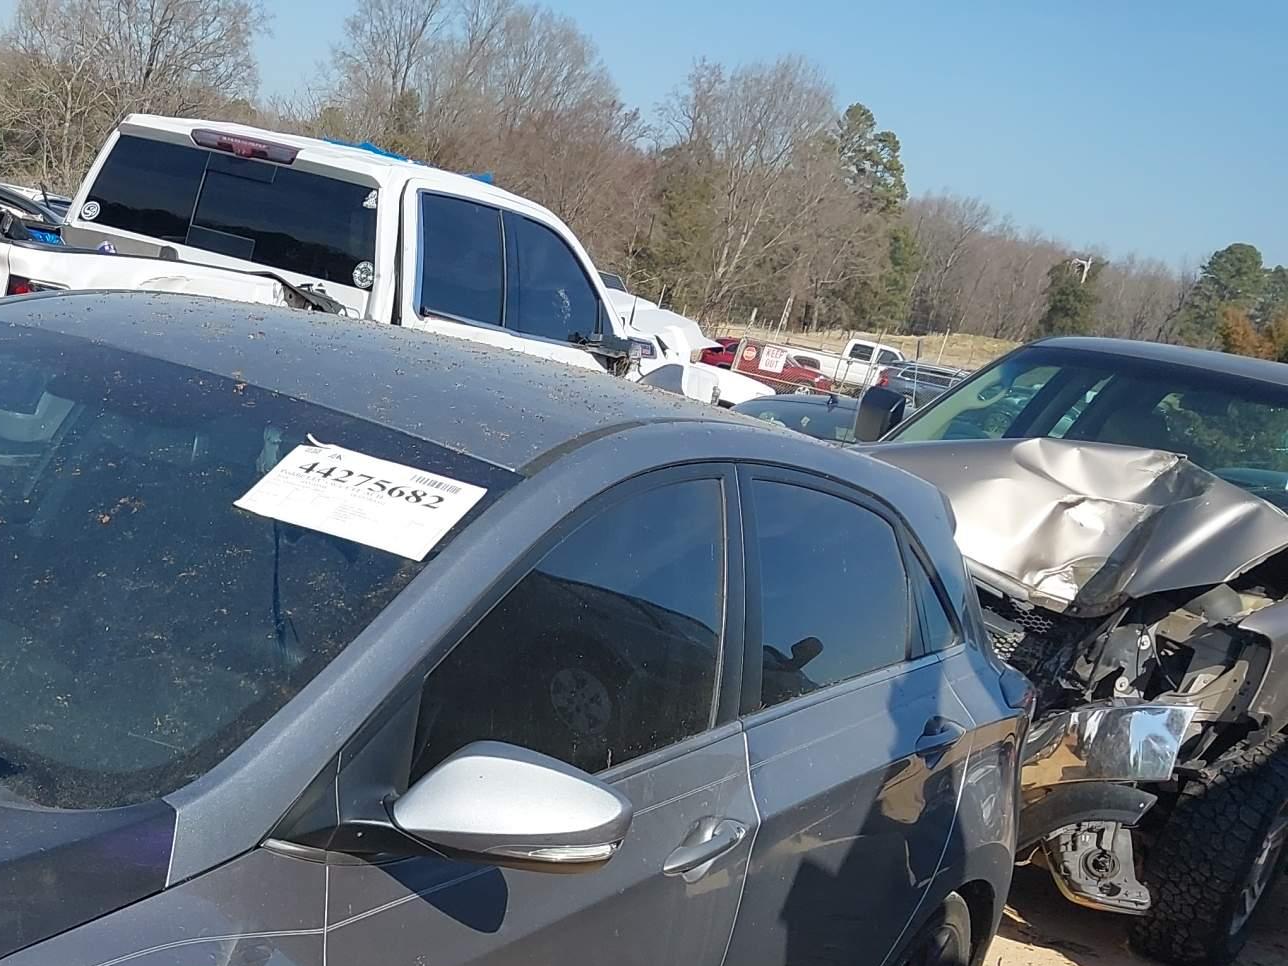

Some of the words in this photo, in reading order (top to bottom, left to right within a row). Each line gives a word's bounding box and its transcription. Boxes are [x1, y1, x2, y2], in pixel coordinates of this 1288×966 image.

[766, 349, 784, 359] KEEP
[765, 359, 780, 368] OUT
[298, 461, 445, 510] 44275682
